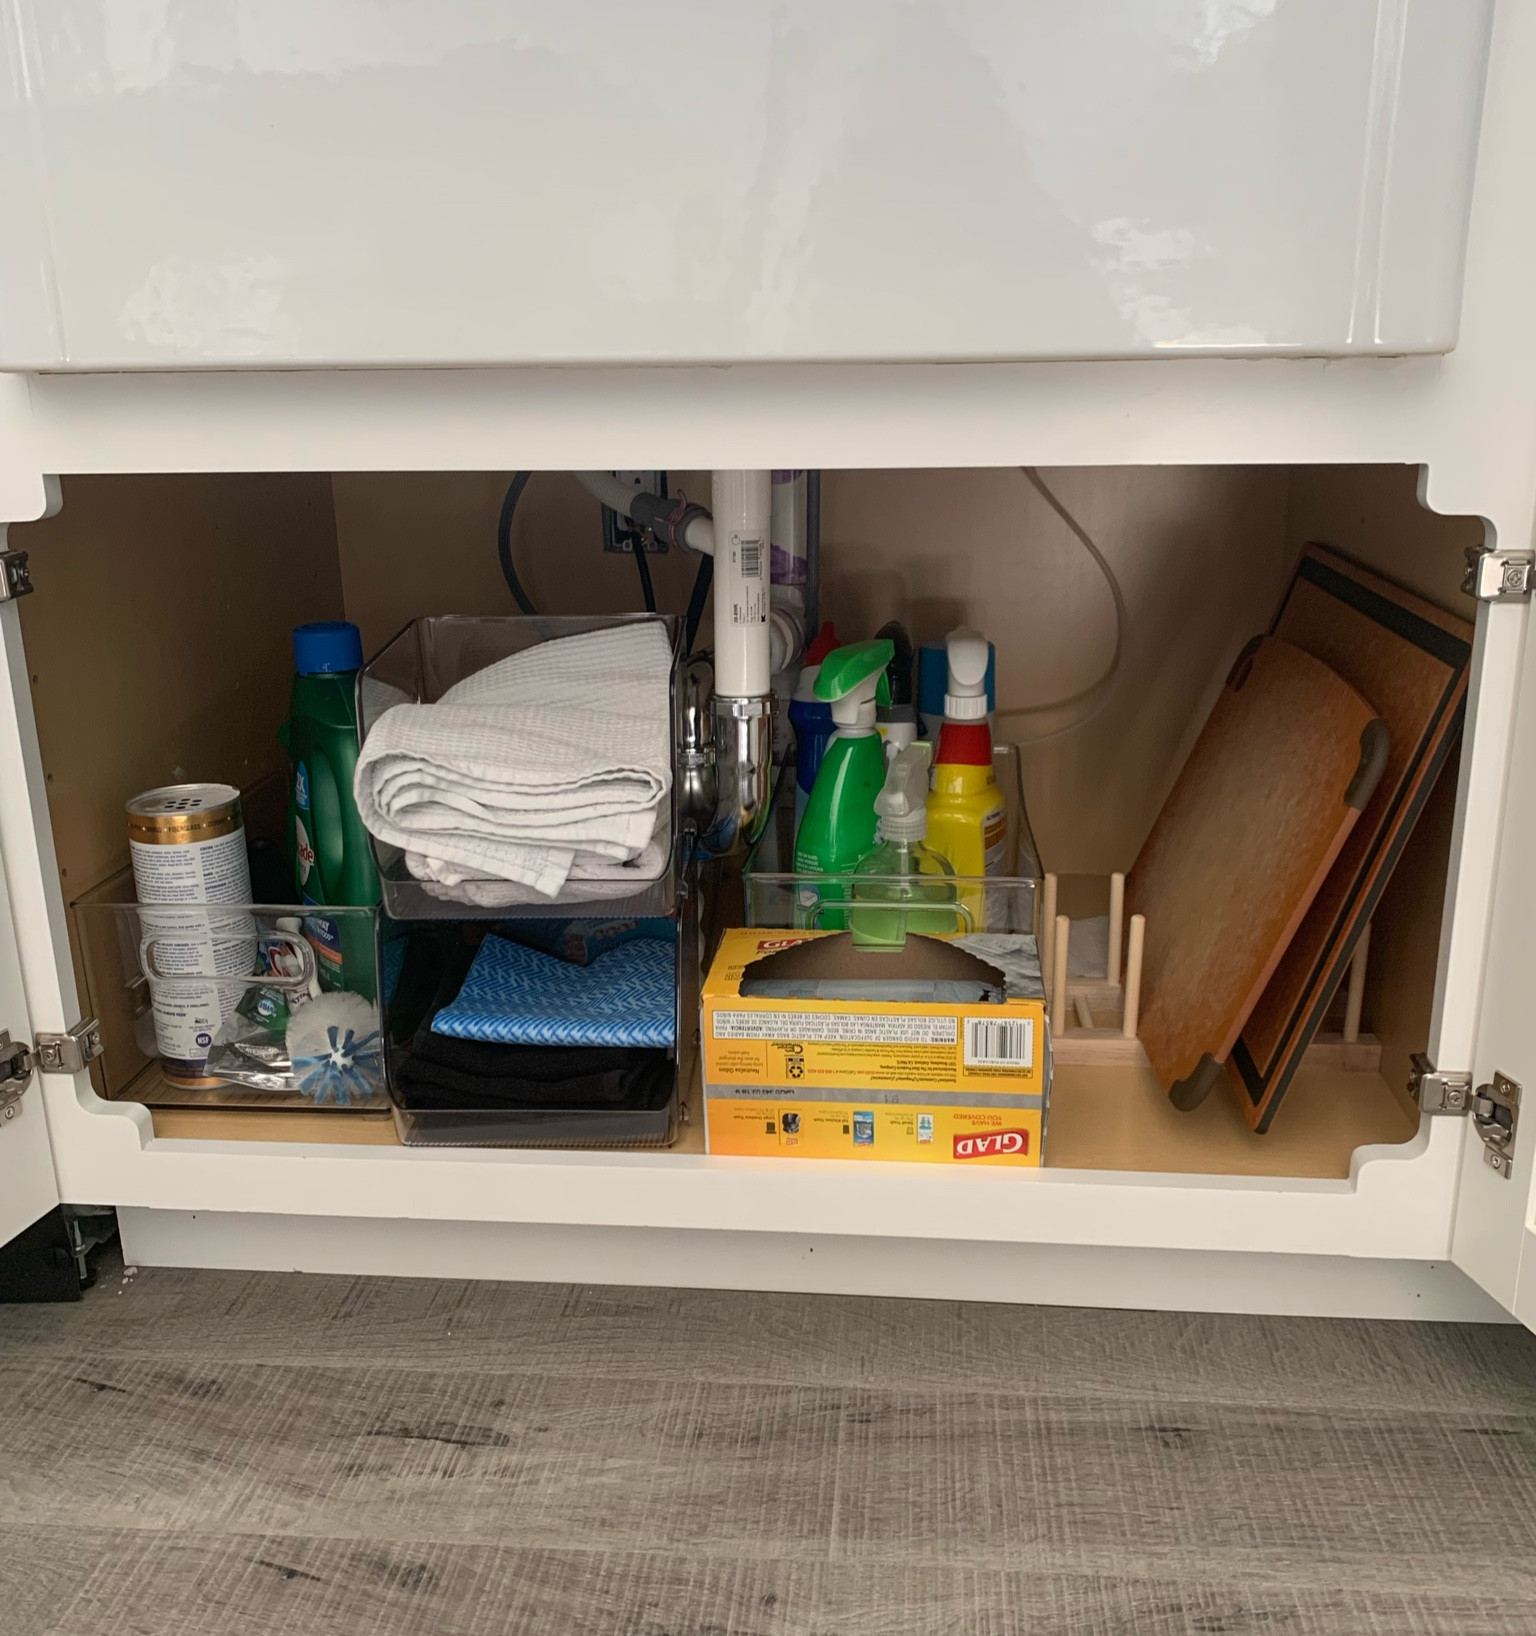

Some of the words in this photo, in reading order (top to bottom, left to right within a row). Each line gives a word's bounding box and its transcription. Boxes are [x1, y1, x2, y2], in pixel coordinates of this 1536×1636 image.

[763, 938, 803, 948] GLA
[197, 1036, 209, 1044] NSF
[956, 1133, 1023, 1154] GLAD
